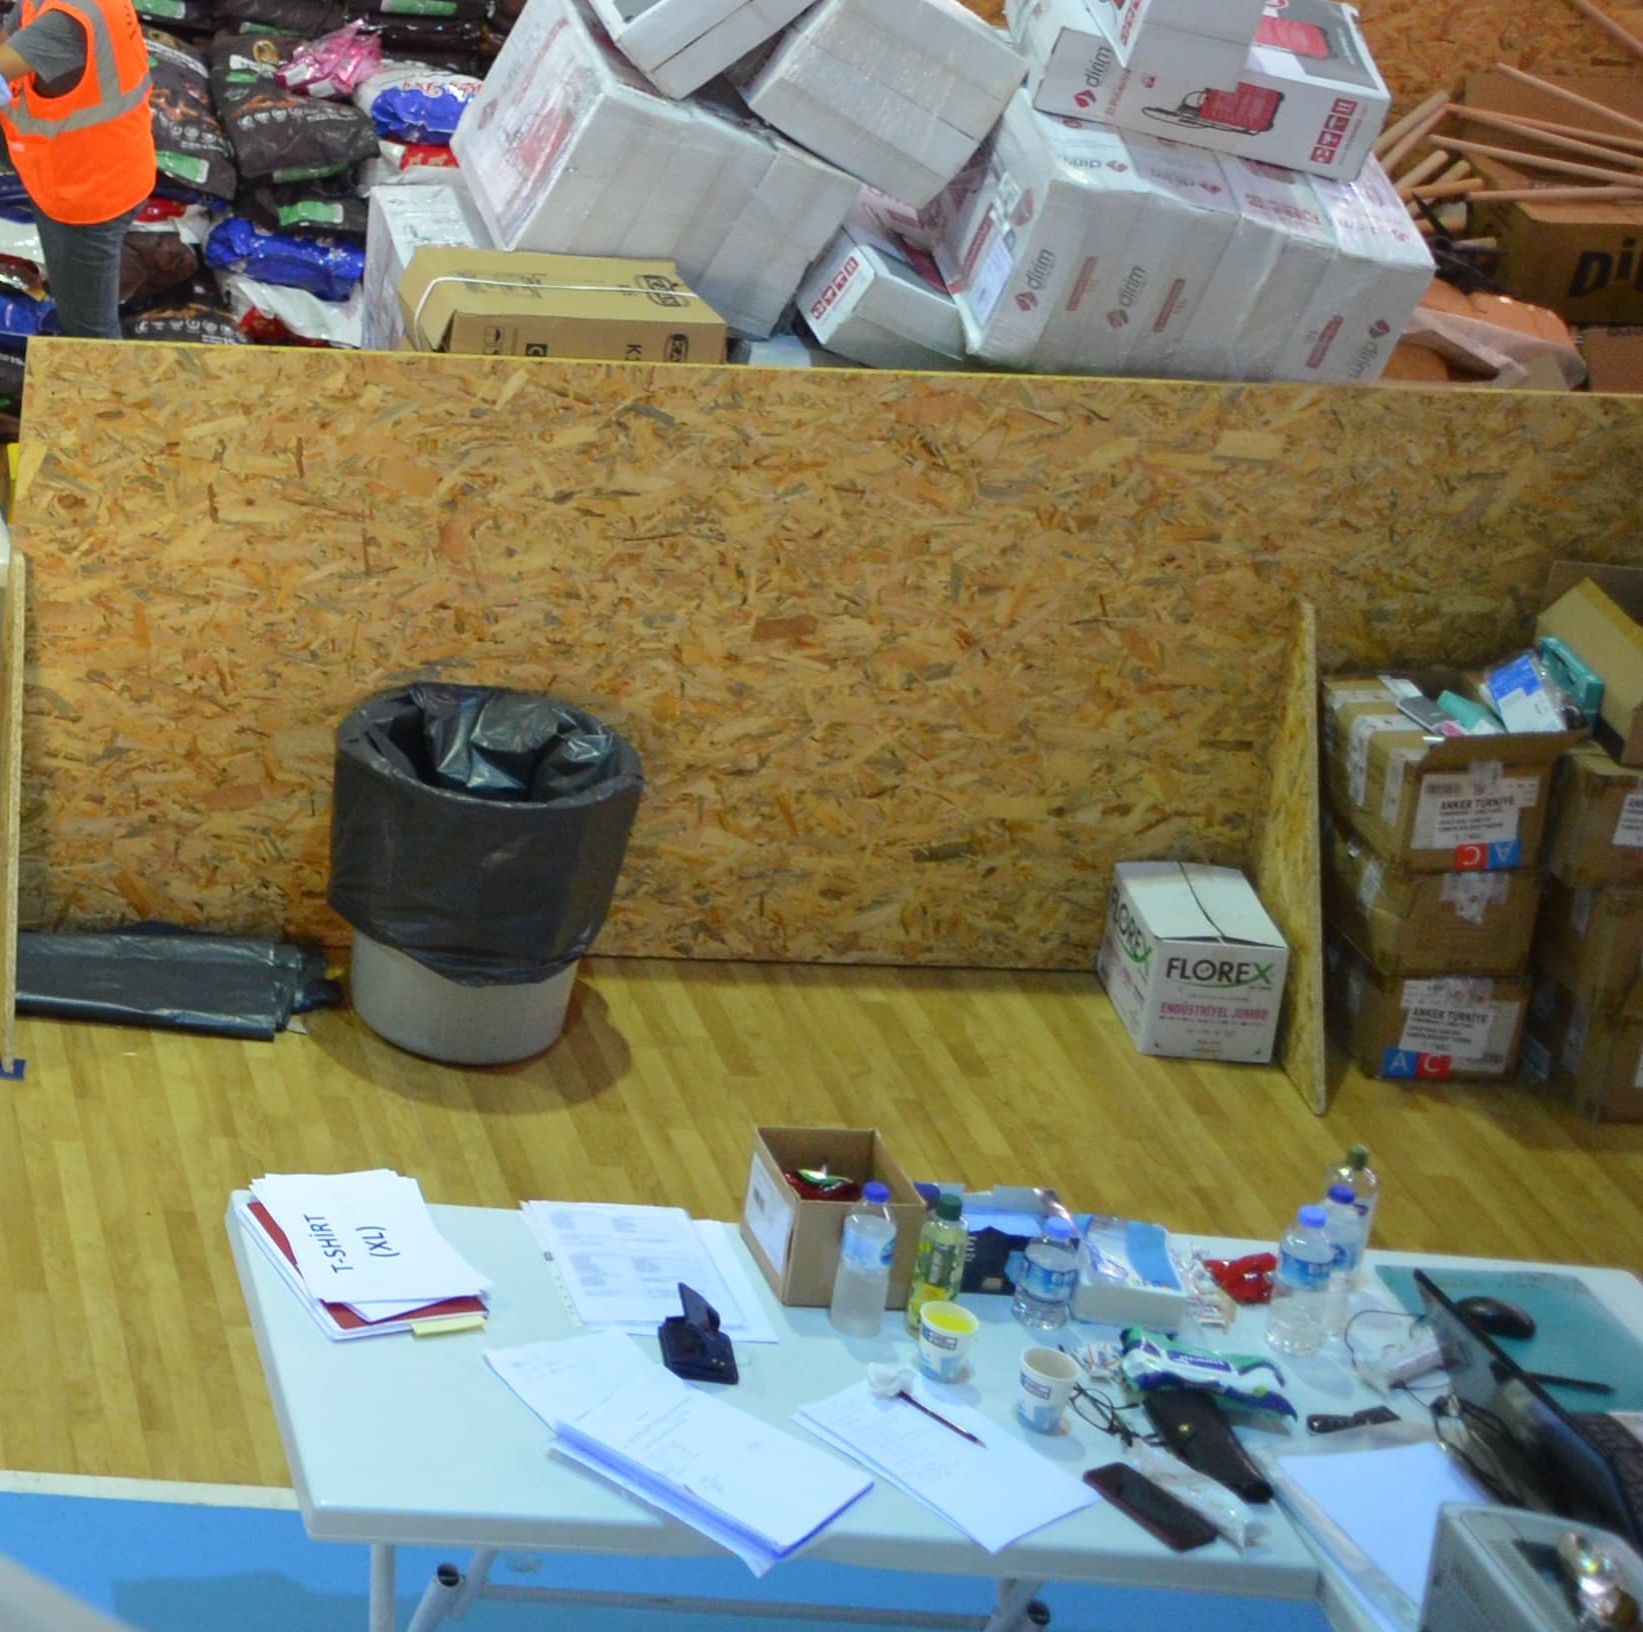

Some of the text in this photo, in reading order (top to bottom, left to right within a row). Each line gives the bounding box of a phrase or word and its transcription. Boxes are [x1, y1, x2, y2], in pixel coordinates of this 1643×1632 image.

[1086, 45, 1113, 89] dirim
[1028, 248, 1056, 292] dirim
[1118, 264, 1148, 308] dirim
[1440, 797, 1473, 811] ANKER
[1166, 957, 1275, 985] FLOREX
[1412, 1007, 1446, 1019] ANKER
[1388, 1051, 1439, 1073] A C
[303, 1214, 355, 1275] T-SHİRT
[355, 1226, 401, 1257] (XL)
